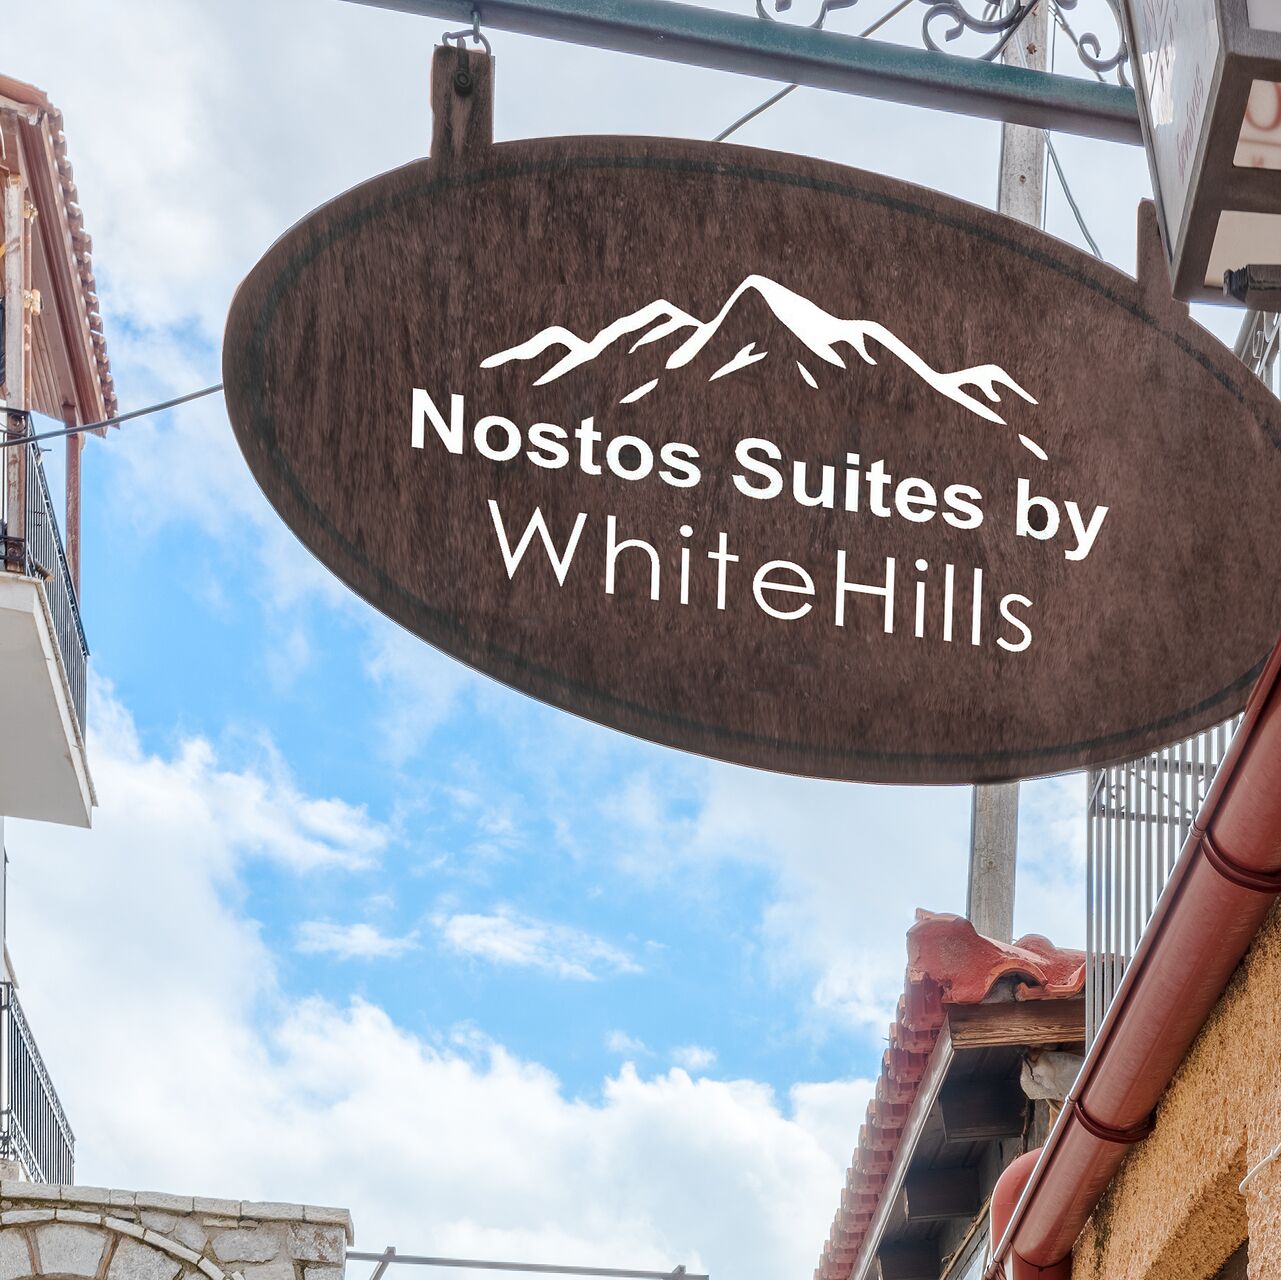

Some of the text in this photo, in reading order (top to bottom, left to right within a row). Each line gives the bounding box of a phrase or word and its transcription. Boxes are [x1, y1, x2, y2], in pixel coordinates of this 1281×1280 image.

[410, 387, 1110, 562] Nostos Suites by
[486, 498, 1034, 653] WhiteHills
